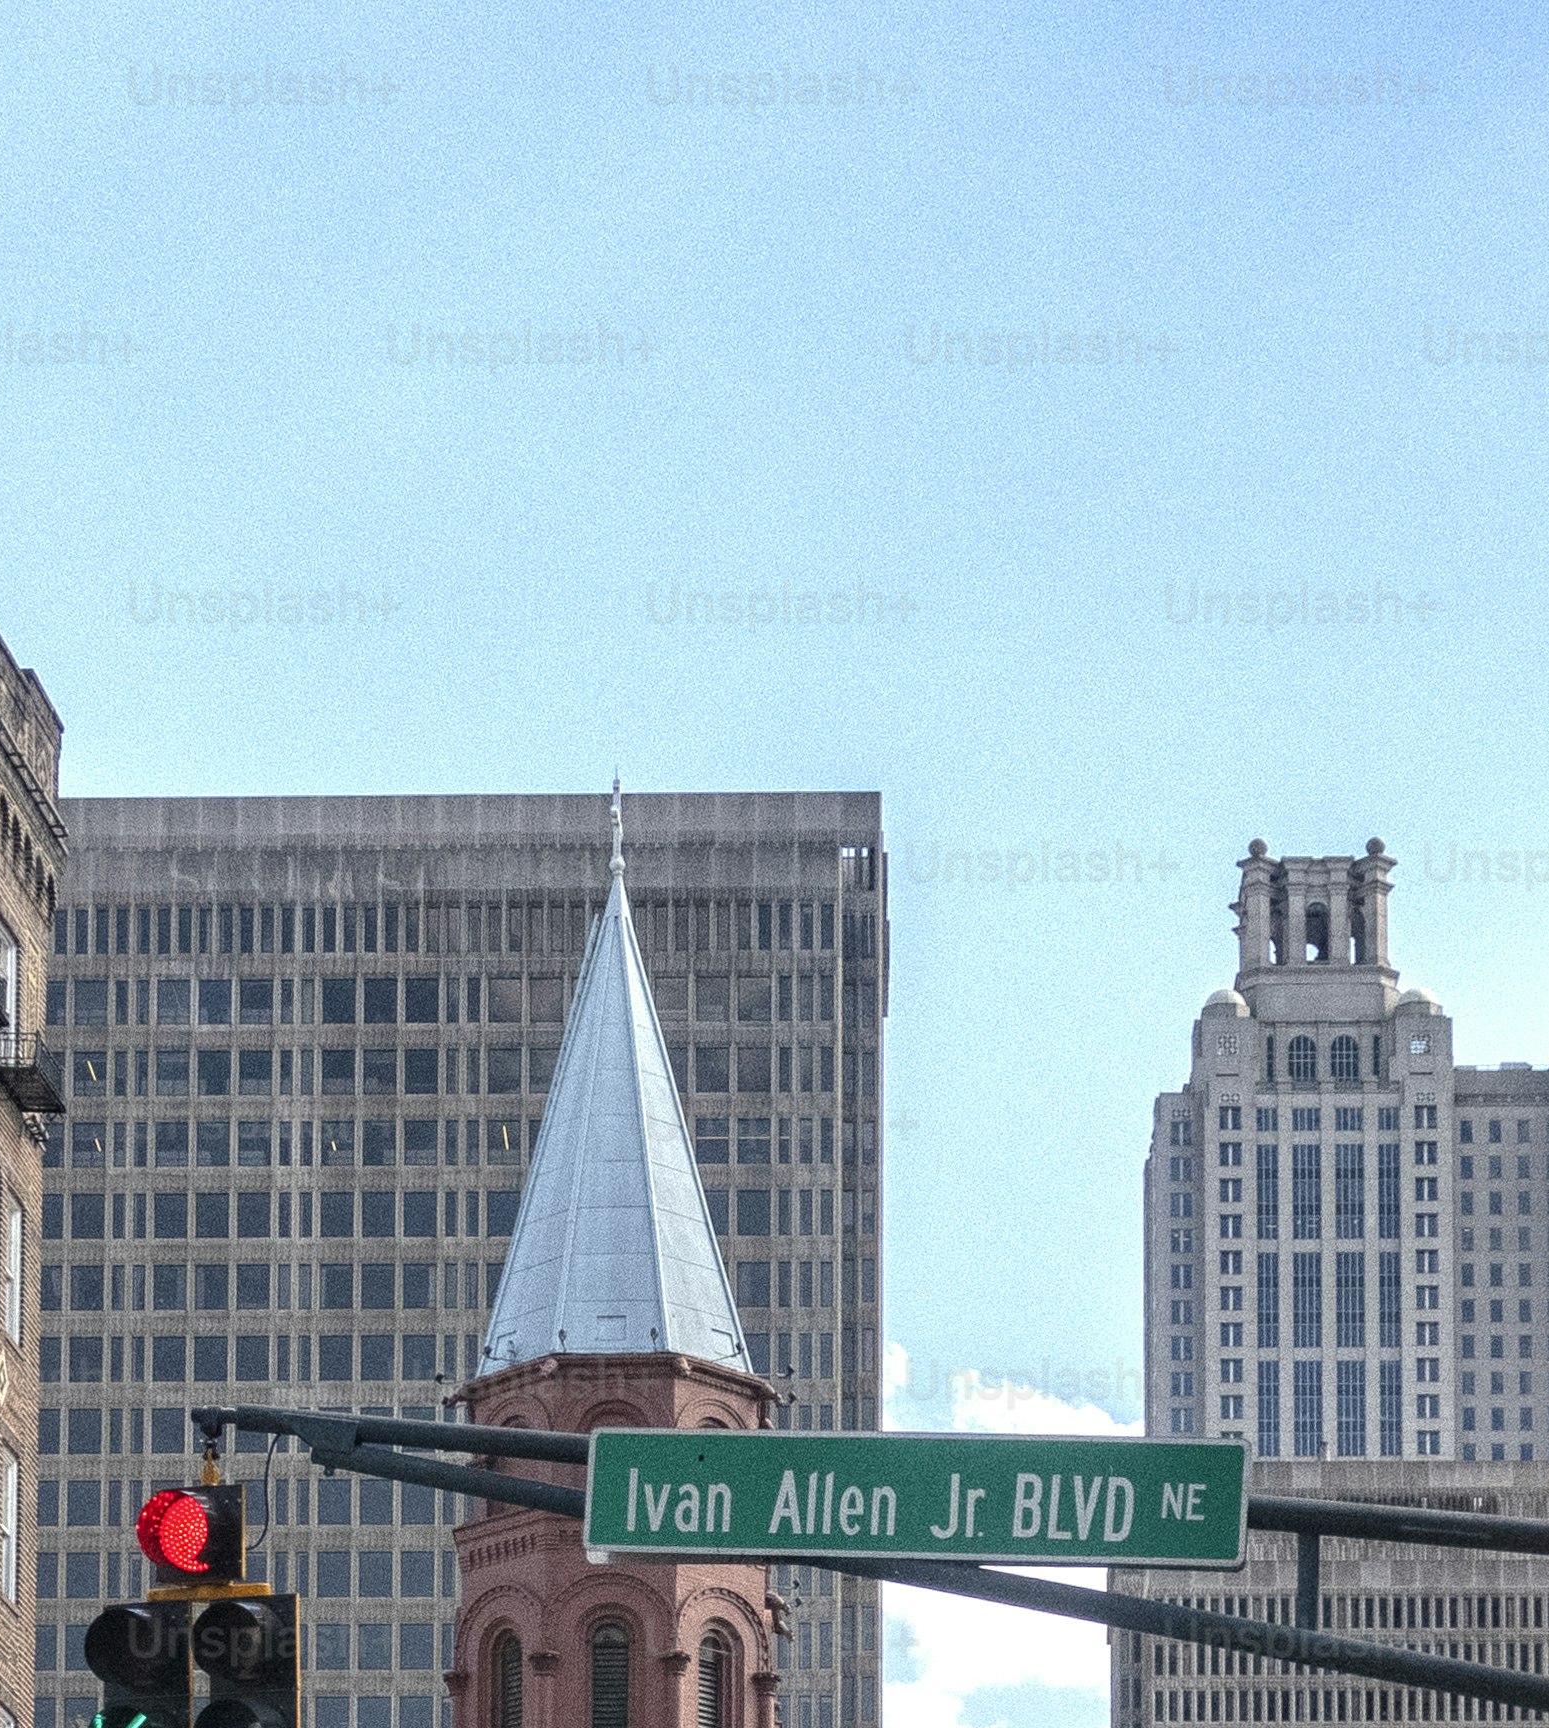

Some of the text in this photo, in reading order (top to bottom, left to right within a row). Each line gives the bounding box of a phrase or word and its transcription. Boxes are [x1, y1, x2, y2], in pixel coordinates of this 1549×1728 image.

[626, 1467, 1207, 1542] Ivan Allen Jr. BLVD NE
